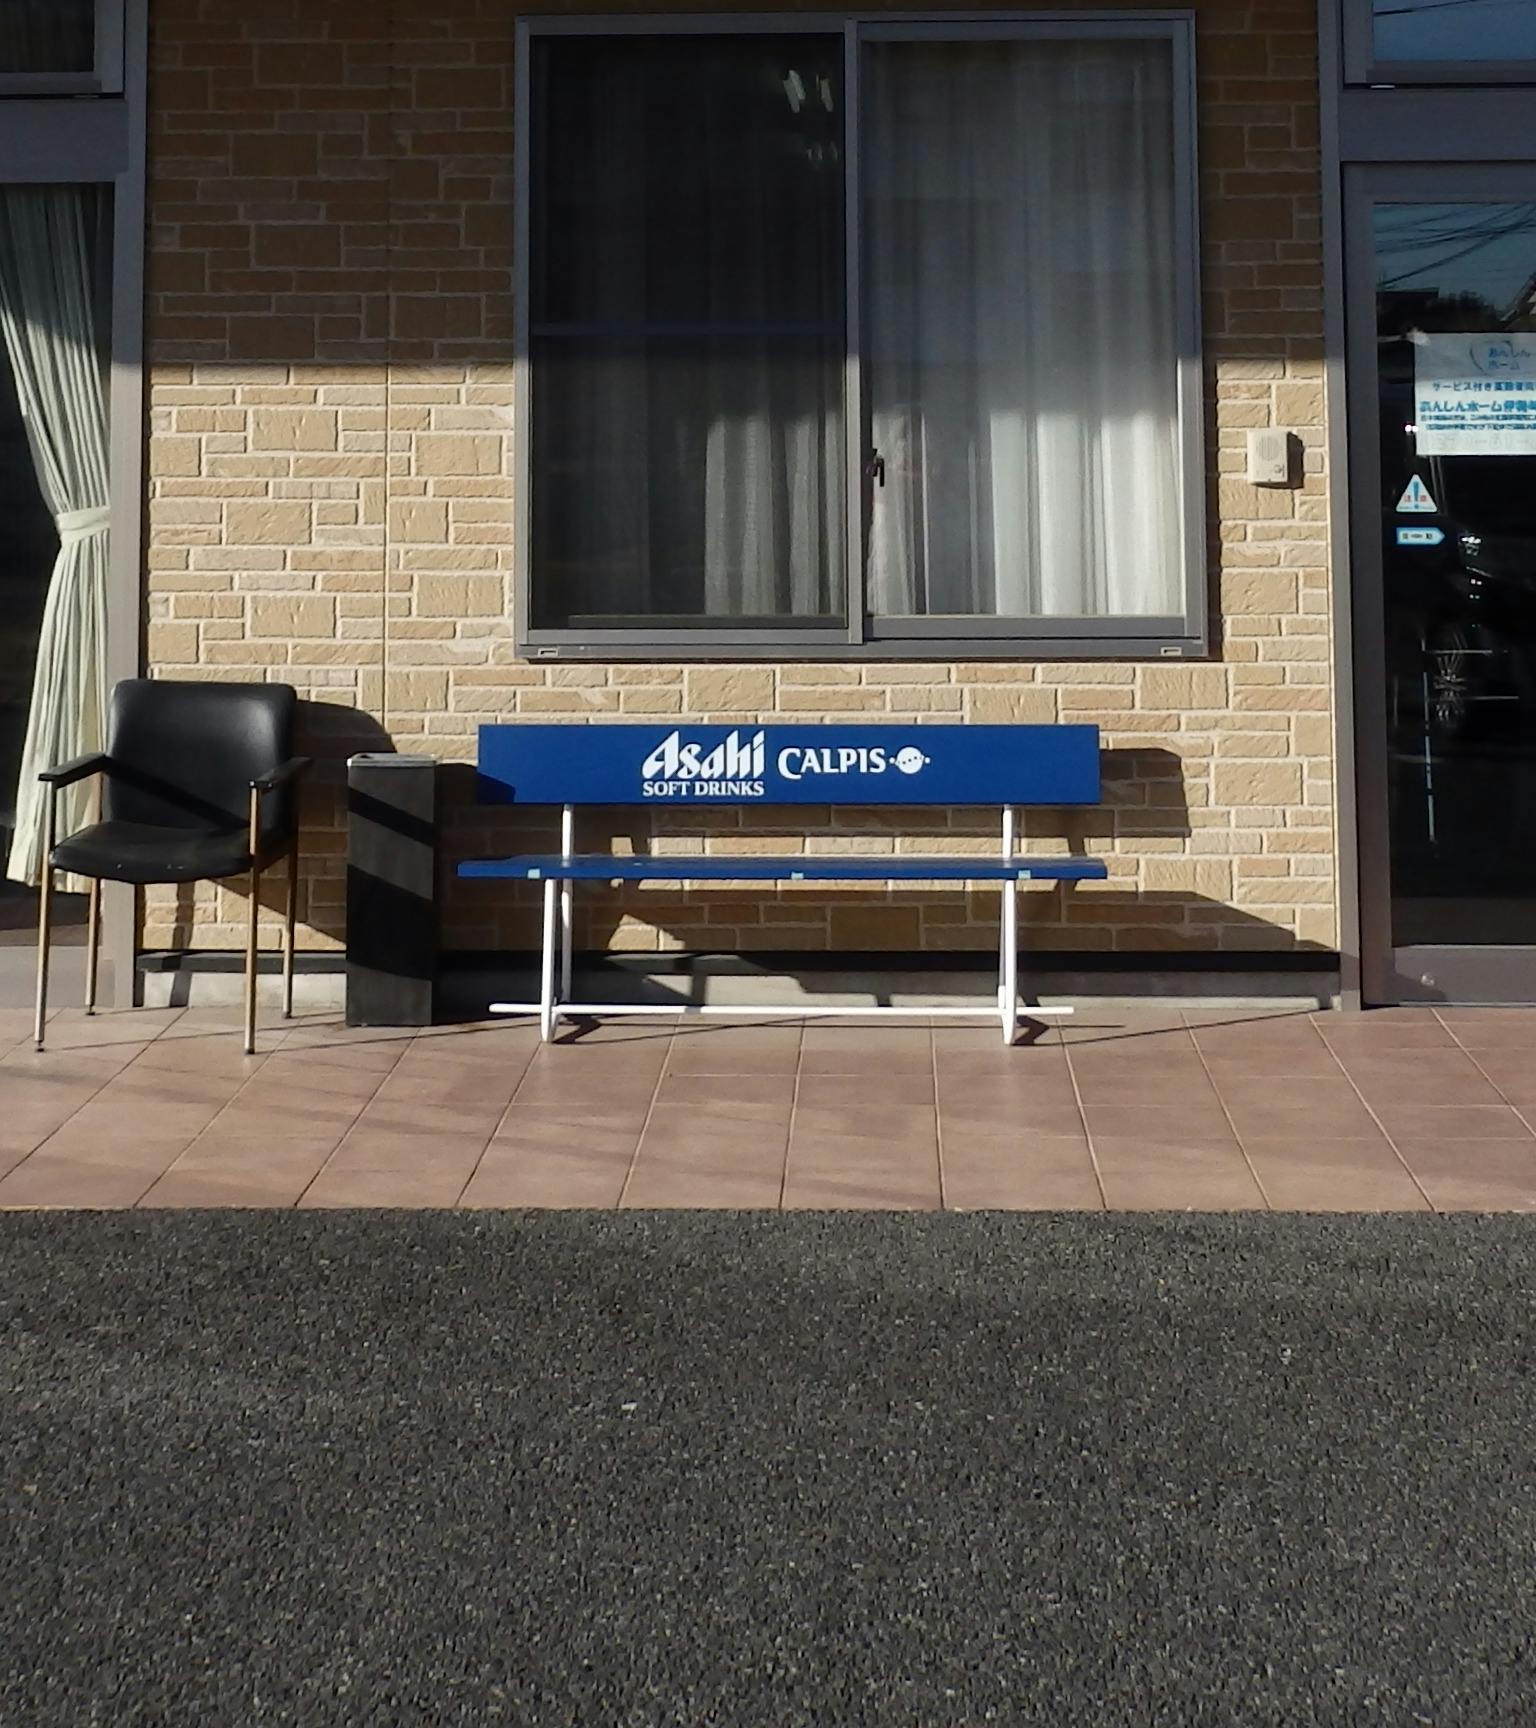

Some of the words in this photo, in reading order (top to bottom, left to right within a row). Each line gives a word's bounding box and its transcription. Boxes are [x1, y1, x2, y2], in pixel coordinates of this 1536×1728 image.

[642, 729, 765, 779] Asahi
[778, 747, 887, 780] CALPIS
[642, 780, 689, 797] SOFT
[693, 780, 765, 797] DRINKS
